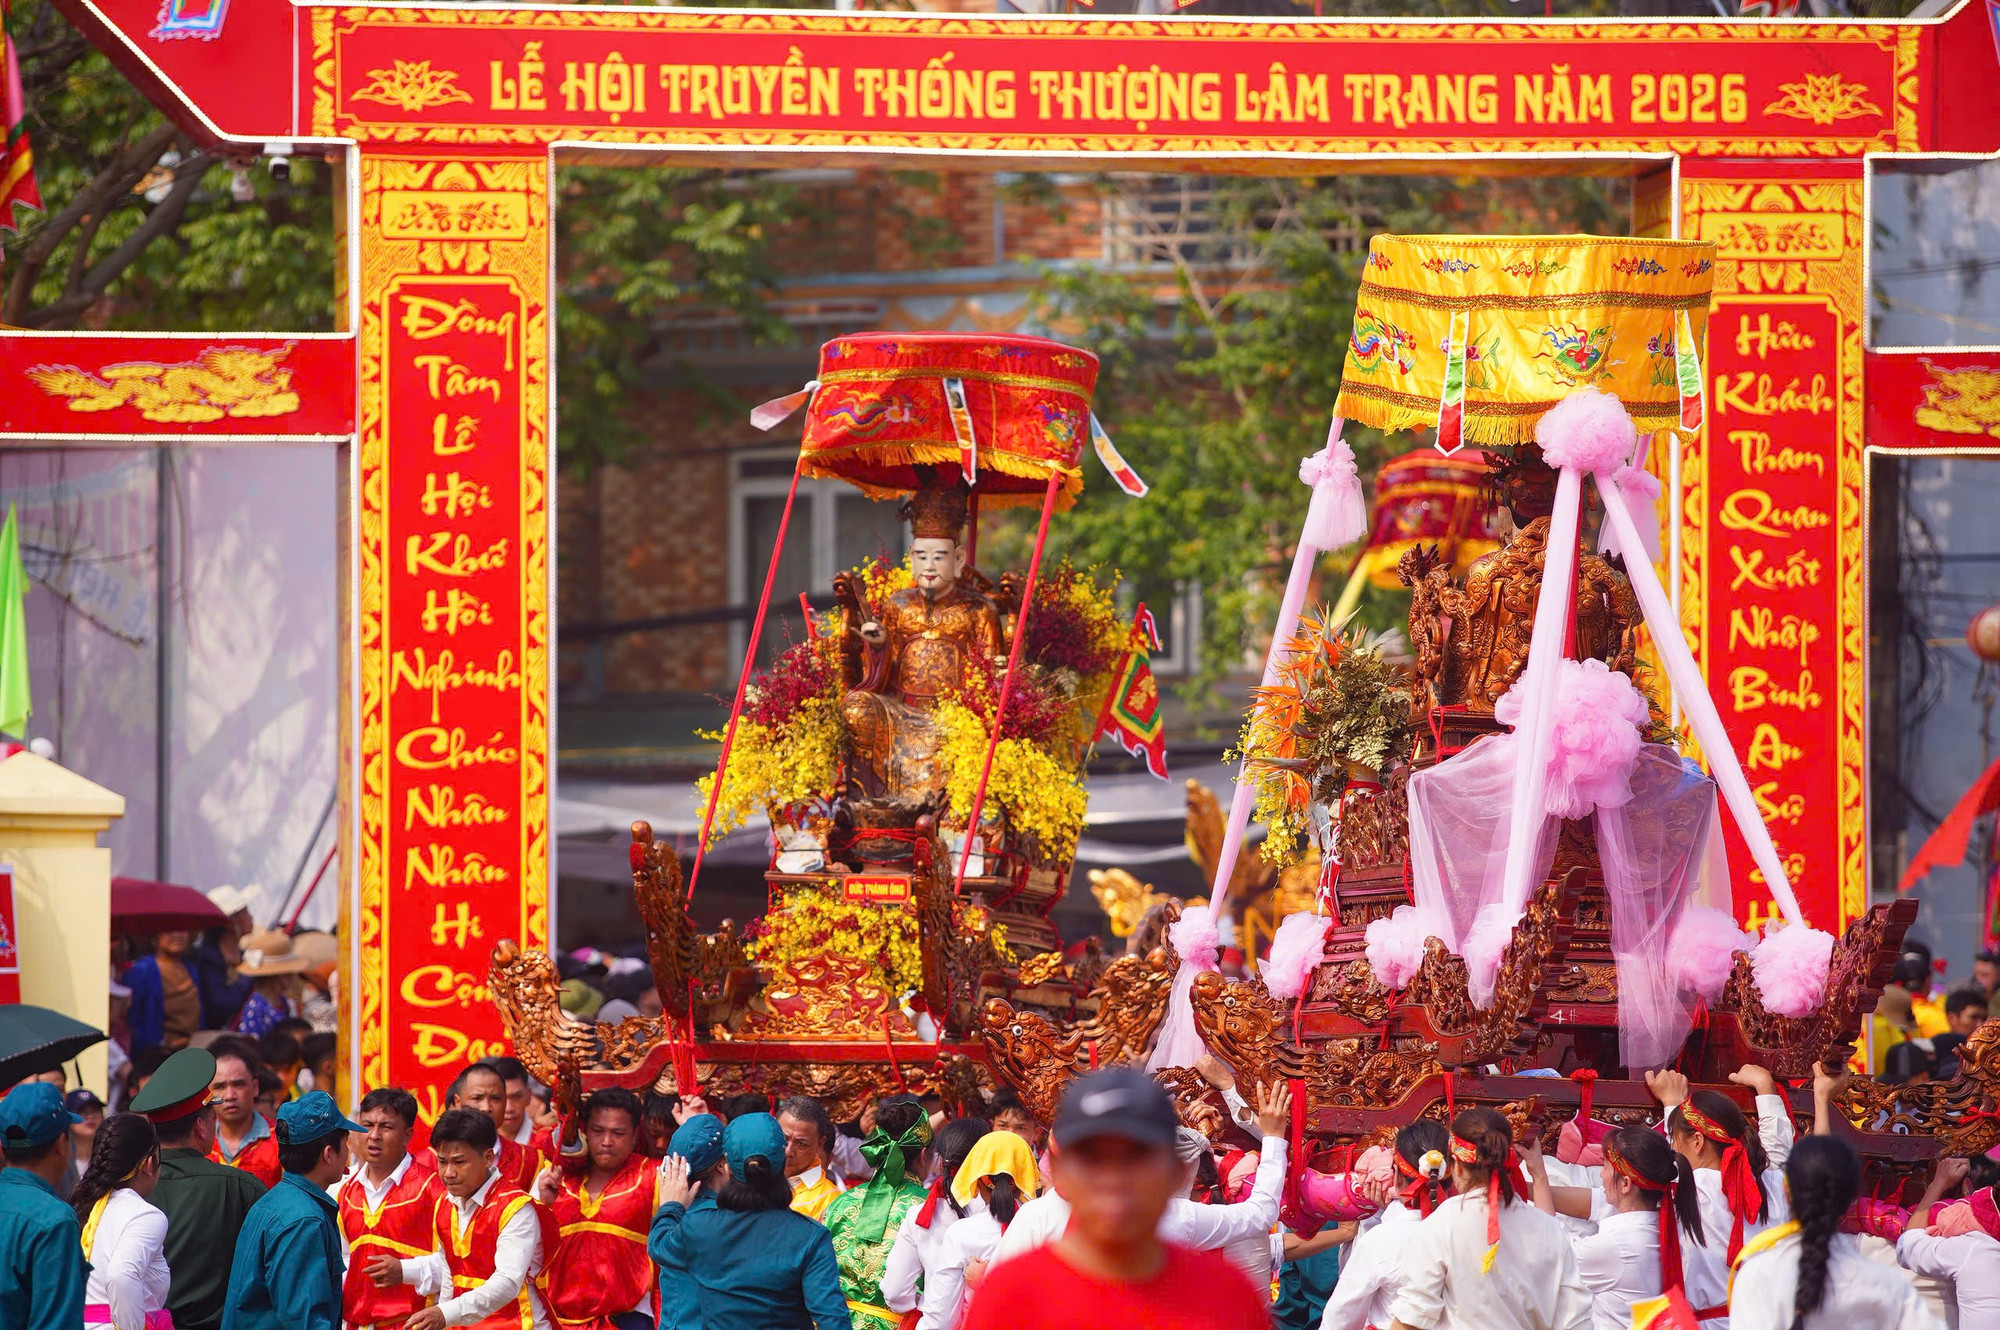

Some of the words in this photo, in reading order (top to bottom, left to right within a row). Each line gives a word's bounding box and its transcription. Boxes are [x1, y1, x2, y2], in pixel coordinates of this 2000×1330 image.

[489, 40, 547, 112] LỄ
[559, 51, 646, 124] HỘI
[659, 45, 841, 120] TRUYỀN
[853, 50, 1018, 120] THỐNG
[1029, 63, 1222, 132] THƯỢNG
[1234, 61, 1331, 123] LÂM
[1343, 73, 1499, 129] TRANG
[1514, 63, 1614, 124] NĂM
[1630, 73, 1748, 123] 2026
[399, 294, 517, 371] Đồng
[1735, 312, 1817, 360] Hữu
[413, 355, 501, 404] Tâm
[1715, 371, 1834, 416] Khách
[433, 412, 481, 456] Lễ
[1727, 430, 1824, 479] Tham
[421, 471, 494, 519] Hội
[1719, 488, 1830, 538] Quan
[406, 531, 508, 577] Khứ
[1729, 544, 1821, 592] Xuất
[421, 587, 494, 636] Hồi
[1729, 604, 1820, 668] Nhập
[390, 647, 520, 724] Nghinh
[1728, 665, 1822, 712] Bình
[395, 726, 518, 770] Chúc
[1747, 722, 1804, 770] An
[405, 783, 510, 832] Nhân
[405, 842, 510, 892] Nhân
[430, 900, 485, 950] Hi
[400, 964, 502, 1012] Cộn
